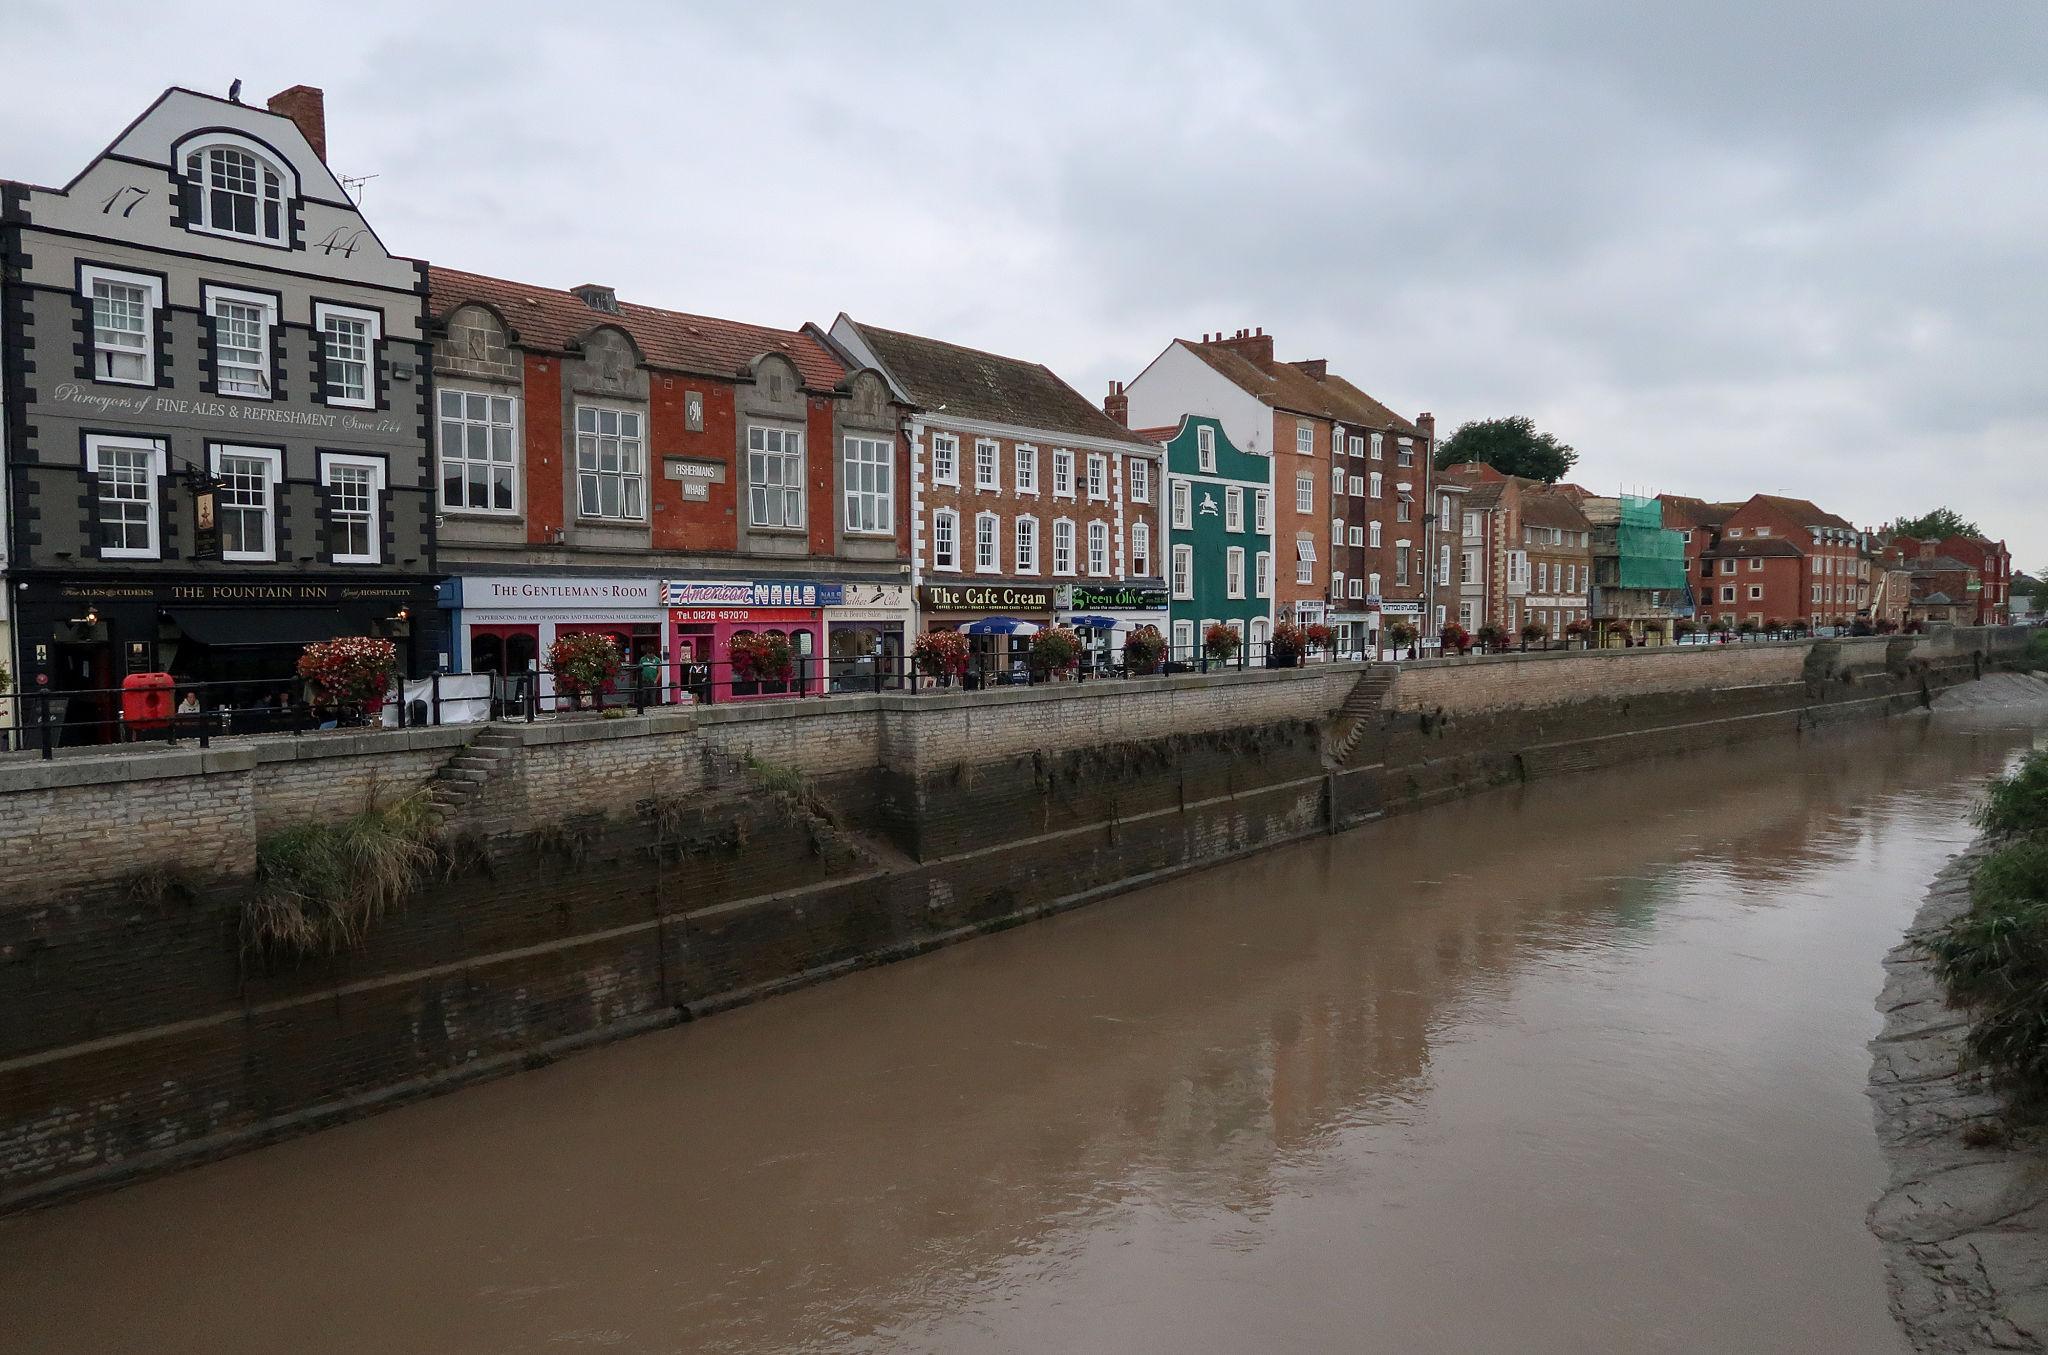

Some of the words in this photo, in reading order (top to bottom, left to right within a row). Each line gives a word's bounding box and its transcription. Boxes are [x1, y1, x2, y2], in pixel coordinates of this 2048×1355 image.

[99, 186, 150, 218] 17
[313, 226, 370, 258] 44
[55, 383, 131, 412] Purveyors
[135, 395, 151, 413] of
[156, 398, 188, 413] FINE
[191, 403, 225, 417] ALES
[229, 405, 240, 418] &
[243, 407, 337, 427] REFRESHMENT
[342, 414, 374, 430] Since
[675, 464, 715, 478] FISHERMANS
[684, 483, 707, 496] WHARF
[172, 586, 205, 598] THE
[213, 586, 293, 598] FOUNTAIN
[301, 586, 328, 598] INN
[492, 584, 518, 596] THE
[612, 585, 648, 597] ROOM
[678, 584, 751, 605] American
[754, 584, 816, 605] NAILS
[930, 587, 960, 604] The
[965, 588, 998, 604] Cafe
[1003, 589, 1047, 605] Cream
[1072, 588, 1112, 609] Green
[1116, 589, 1144, 605] Olive
[693, 611, 716, 619] 01278
